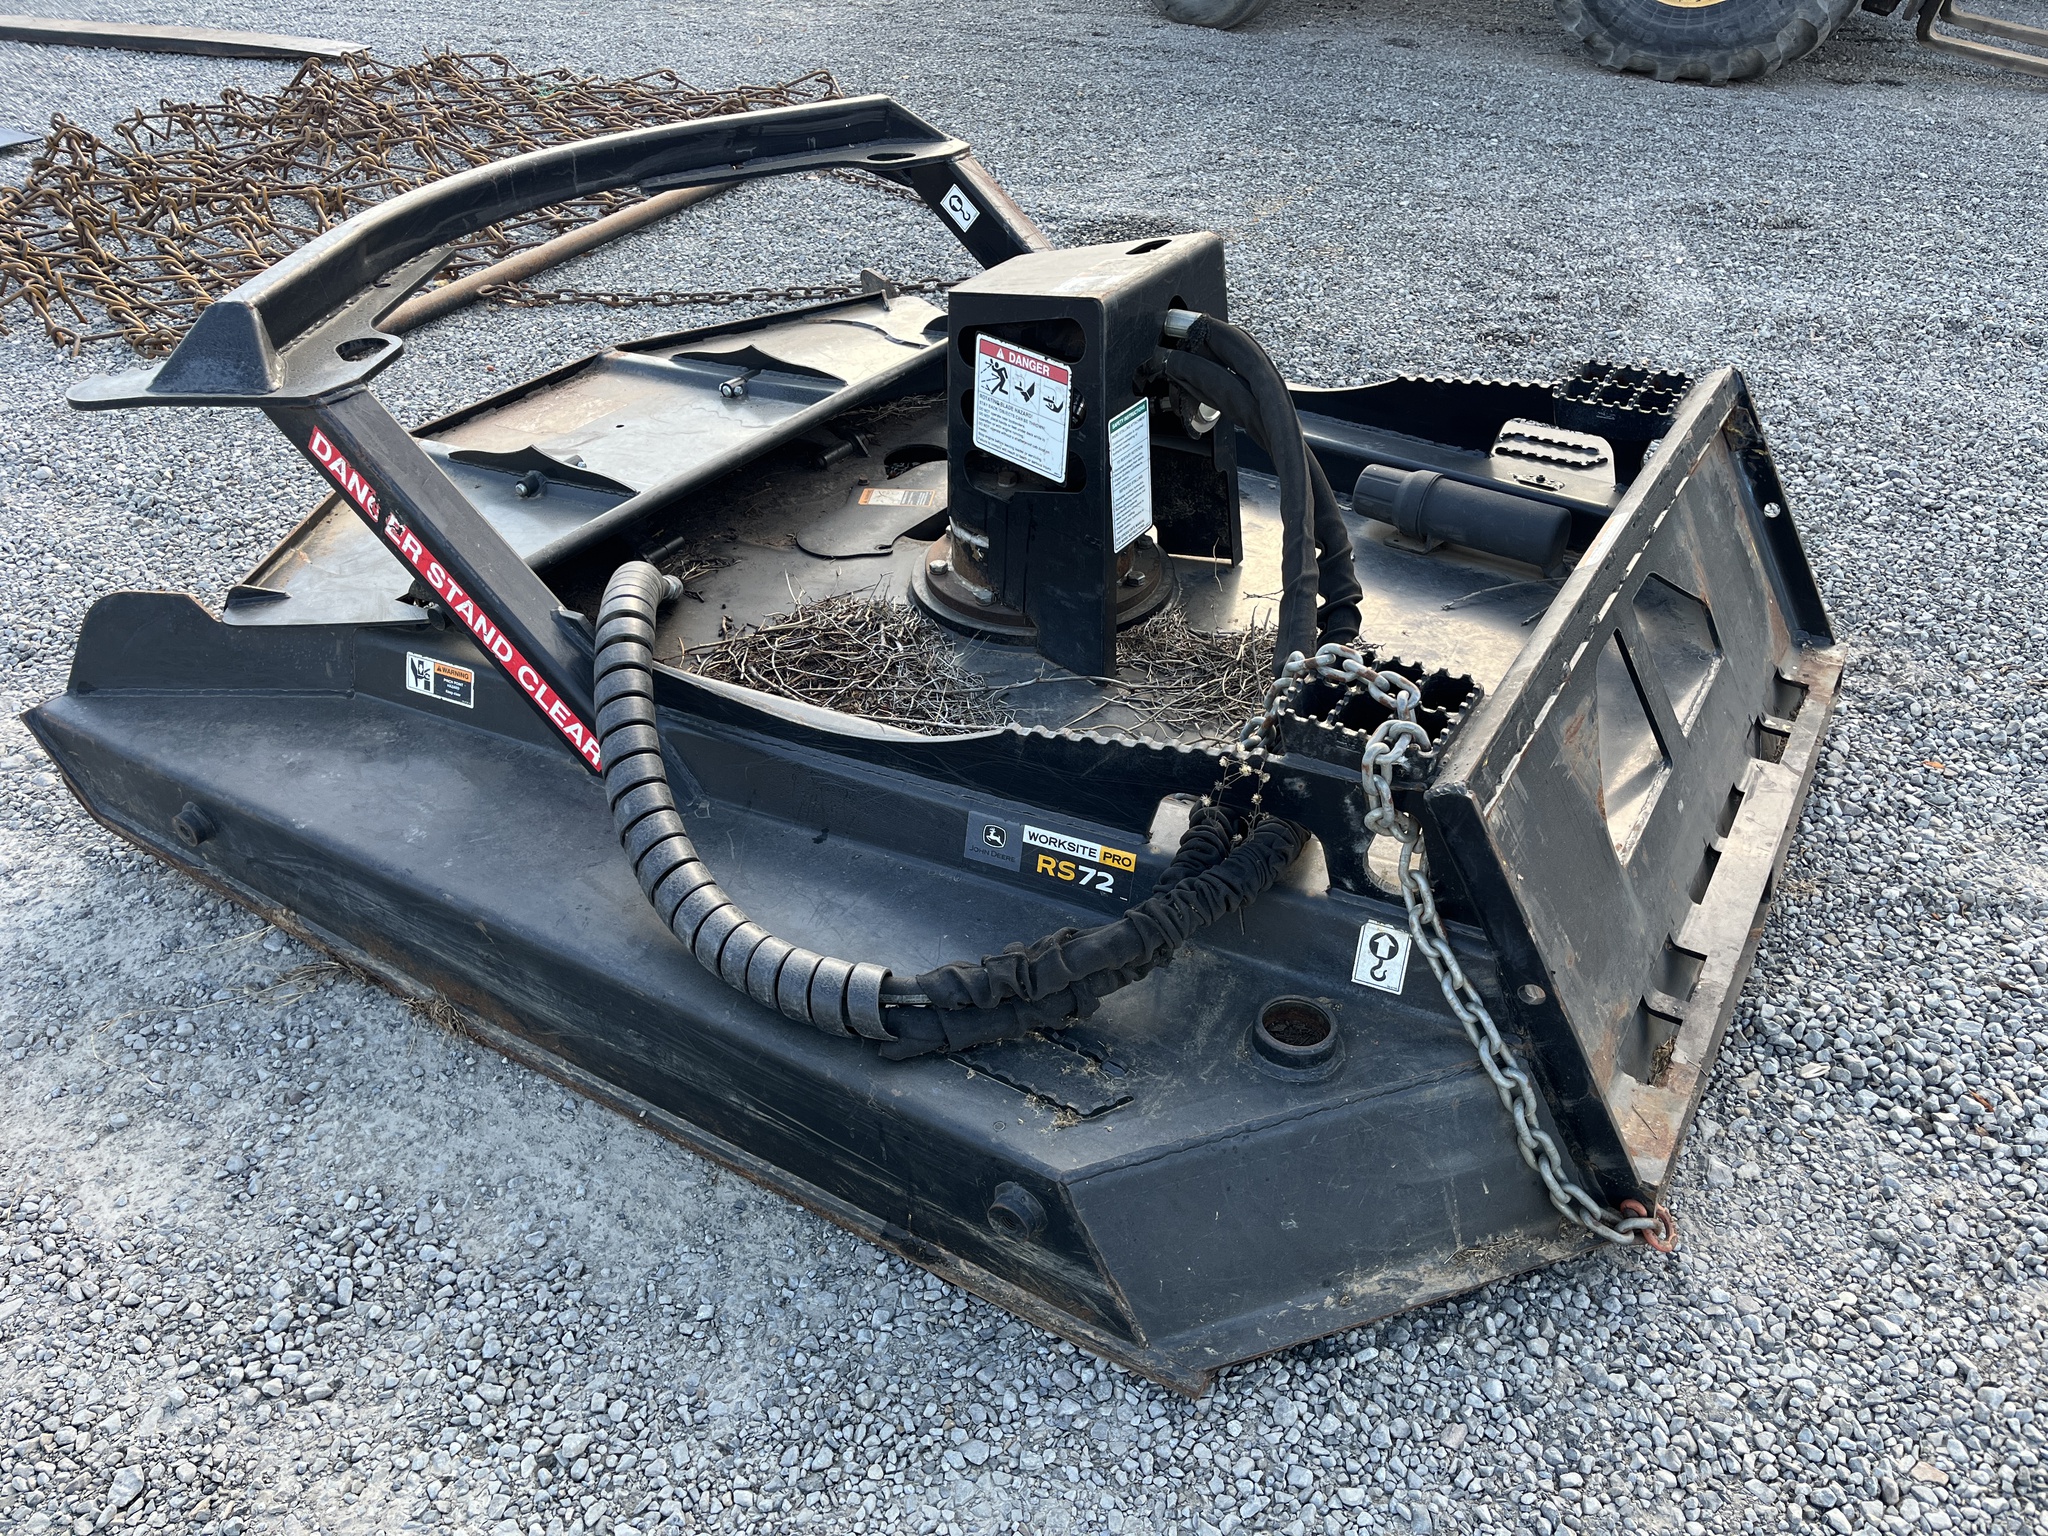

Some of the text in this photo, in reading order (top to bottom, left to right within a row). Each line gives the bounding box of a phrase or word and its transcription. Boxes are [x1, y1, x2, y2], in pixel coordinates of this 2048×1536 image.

[1008, 352, 1050, 377] DANGER
[426, 561, 513, 662] STAND
[518, 665, 602, 767] CLEAR
[442, 667, 469, 679] WARNING
[969, 845, 1015, 863] JOHN DEERE
[1028, 831, 1132, 868] WORKSITE PRO
[1036, 854, 1114, 894] RS72
